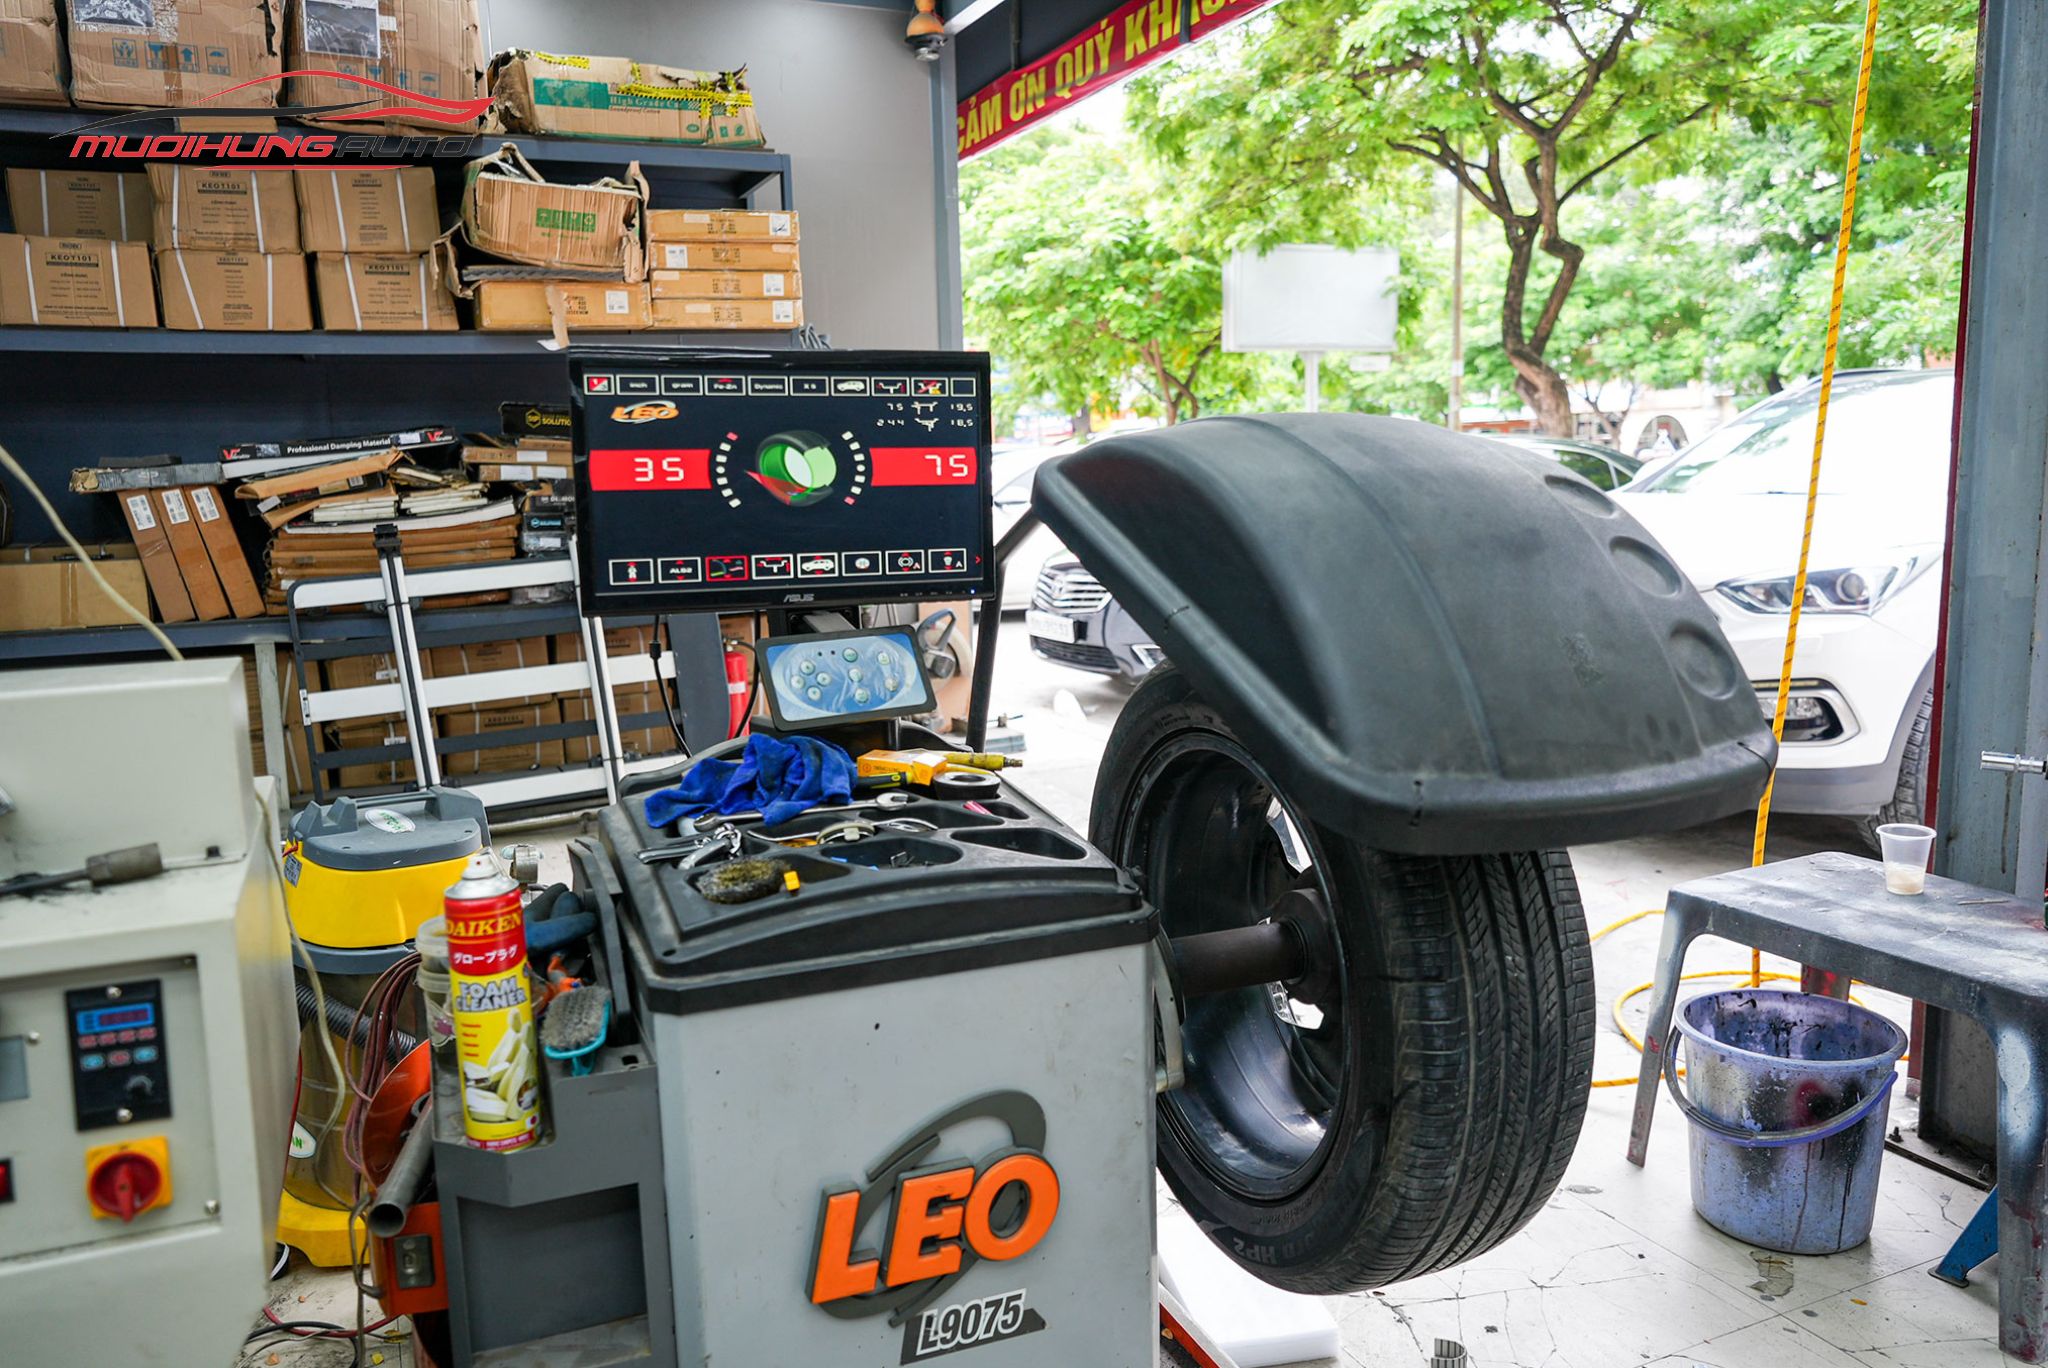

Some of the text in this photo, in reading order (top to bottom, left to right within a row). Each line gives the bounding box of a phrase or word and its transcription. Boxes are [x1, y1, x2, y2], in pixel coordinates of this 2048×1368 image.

[1055, 18, 1114, 99] QUÝ
[201, 182, 241, 190] KEOT101
[50, 254, 92, 262] KEOT101
[671, 382, 693, 390] gram
[611, 406, 679, 420] LEO
[887, 403, 904, 411] 75
[876, 419, 905, 427] 244
[287, 444, 330, 455] Professional
[330, 441, 362, 452] Damping
[362, 438, 391, 448] Material
[633, 454, 968, 482] 35 75
[784, 594, 815, 603] ASUS
[447, 912, 522, 937] DAIKEN
[458, 975, 518, 1000] FOAM
[455, 988, 528, 1012] CLEANER
[808, 1151, 1061, 1305] LEO
[916, 1288, 1027, 1356] L9075
